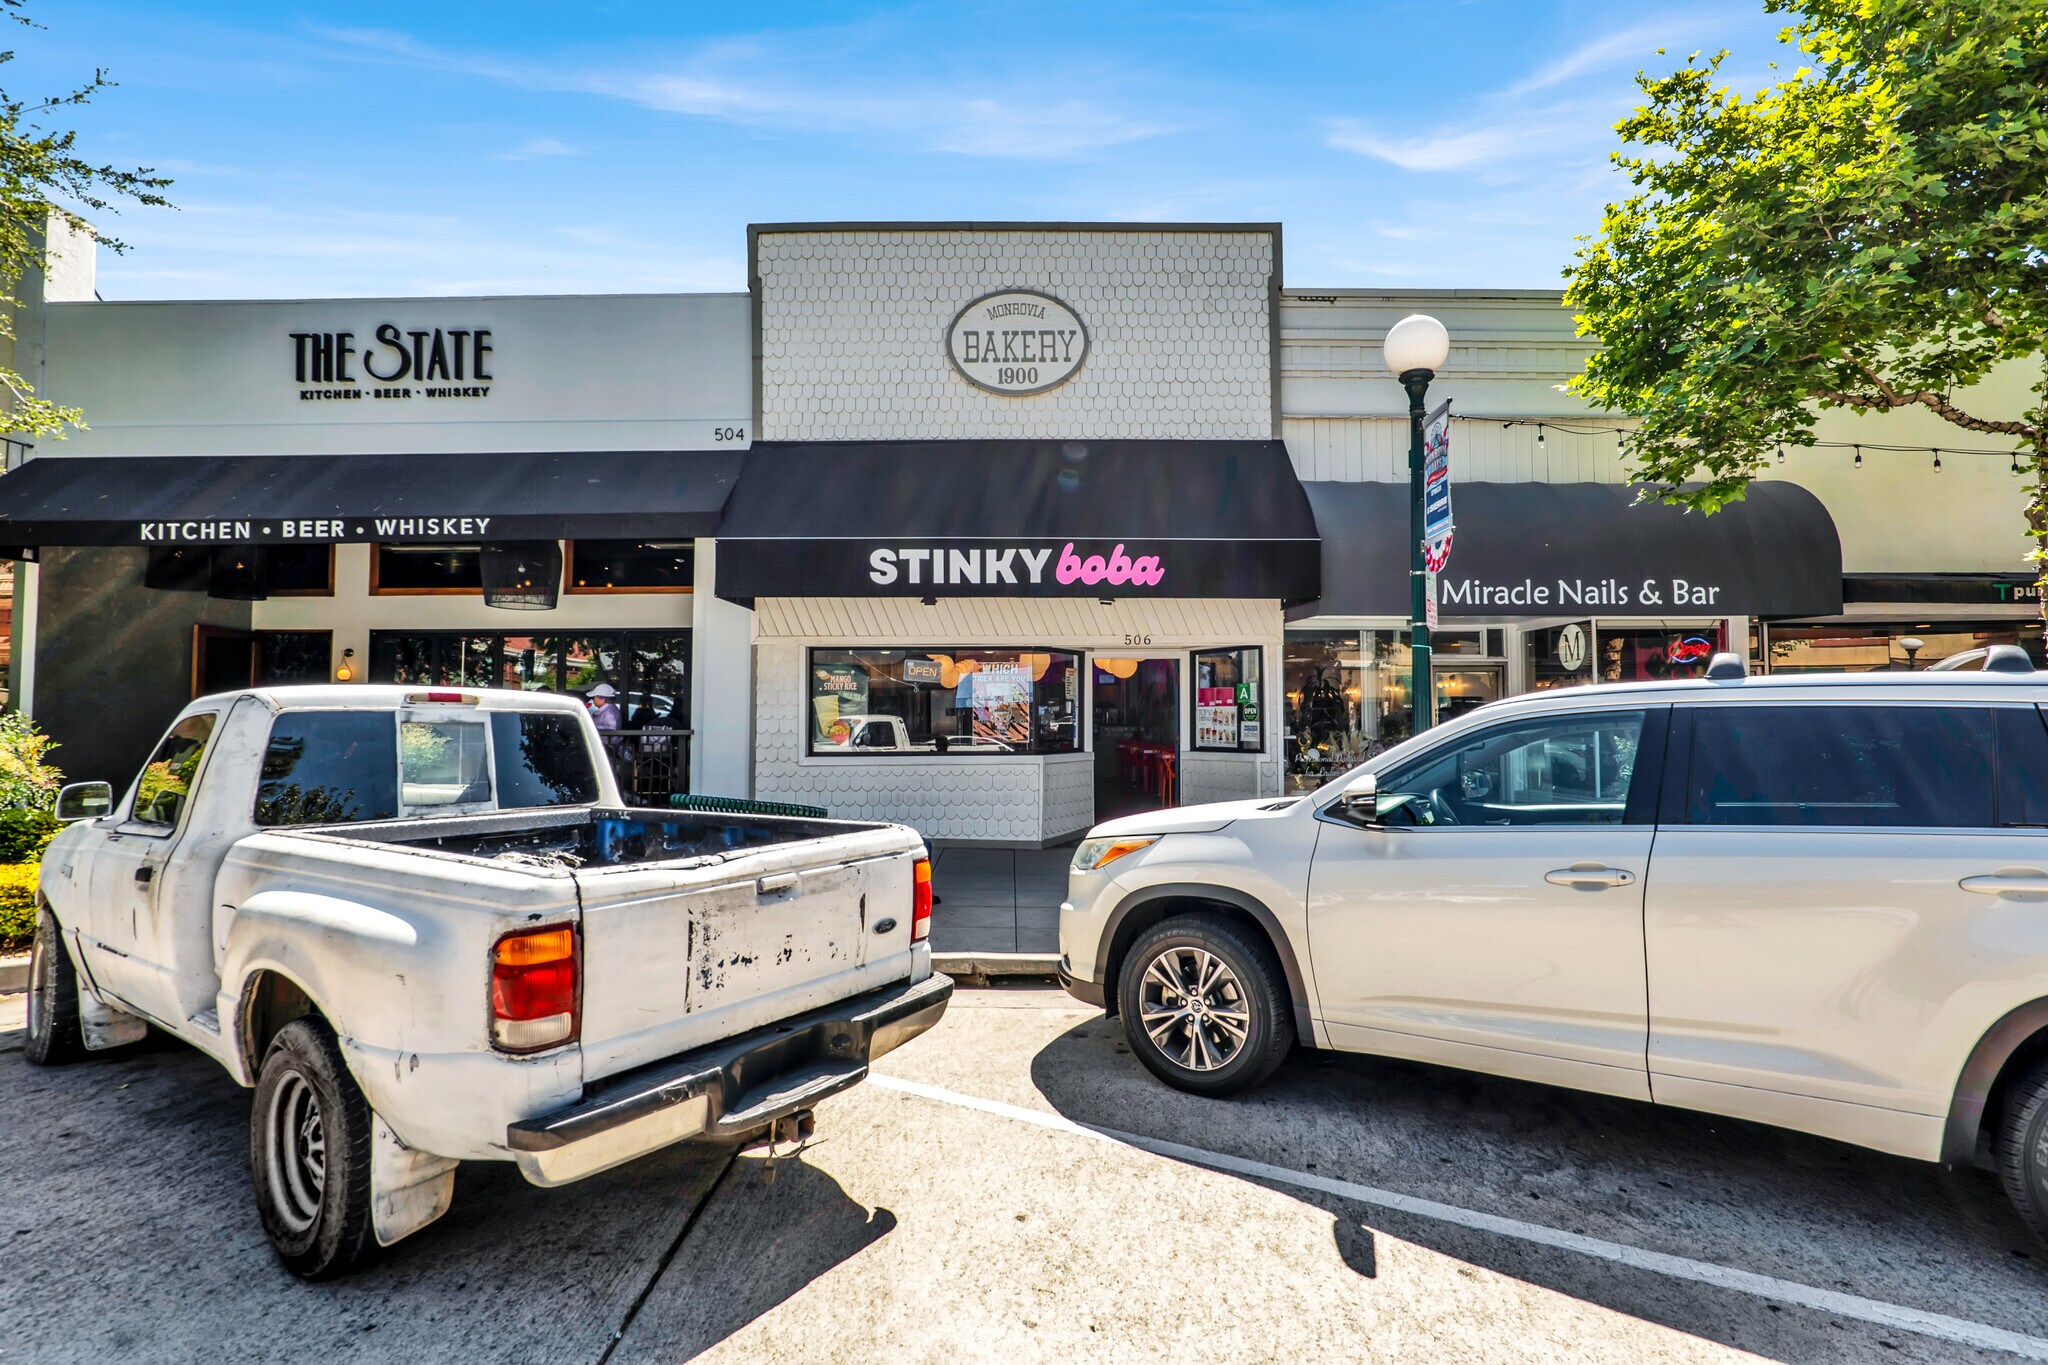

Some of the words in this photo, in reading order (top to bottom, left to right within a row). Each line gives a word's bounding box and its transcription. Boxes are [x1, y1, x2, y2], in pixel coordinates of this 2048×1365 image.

[986, 303, 1046, 321] MONROVIA
[289, 332, 356, 383] THE
[363, 323, 494, 383] STATE
[962, 329, 1077, 364] BAKERY
[997, 367, 1039, 385] 1900
[300, 389, 362, 401] KITCHEN
[374, 388, 412, 399] BEER
[425, 387, 491, 399] WHISKEY
[714, 427, 745, 442] 504
[140, 521, 251, 541] KITCHEN
[282, 520, 345, 538] BEER
[375, 517, 491, 537] WHISKEY
[869, 548, 1053, 585] STINKY
[1055, 542, 1165, 586] boba
[1441, 579, 1549, 605] Miracle
[1558, 579, 1629, 605] Nails
[1638, 579, 1663, 605] &
[1673, 579, 1720, 605] Bar
[1124, 634, 1152, 646] 506
[1562, 630, 1582, 664] M
[908, 666, 937, 677] OPEN
[982, 663, 1019, 675] WHICH
[824, 682, 844, 691] STICKY
[845, 682, 858, 691] RICE
[830, 675, 852, 683] MANGO
[1239, 687, 1249, 699] A
[1152, 929, 1204, 944] EXTENSA
